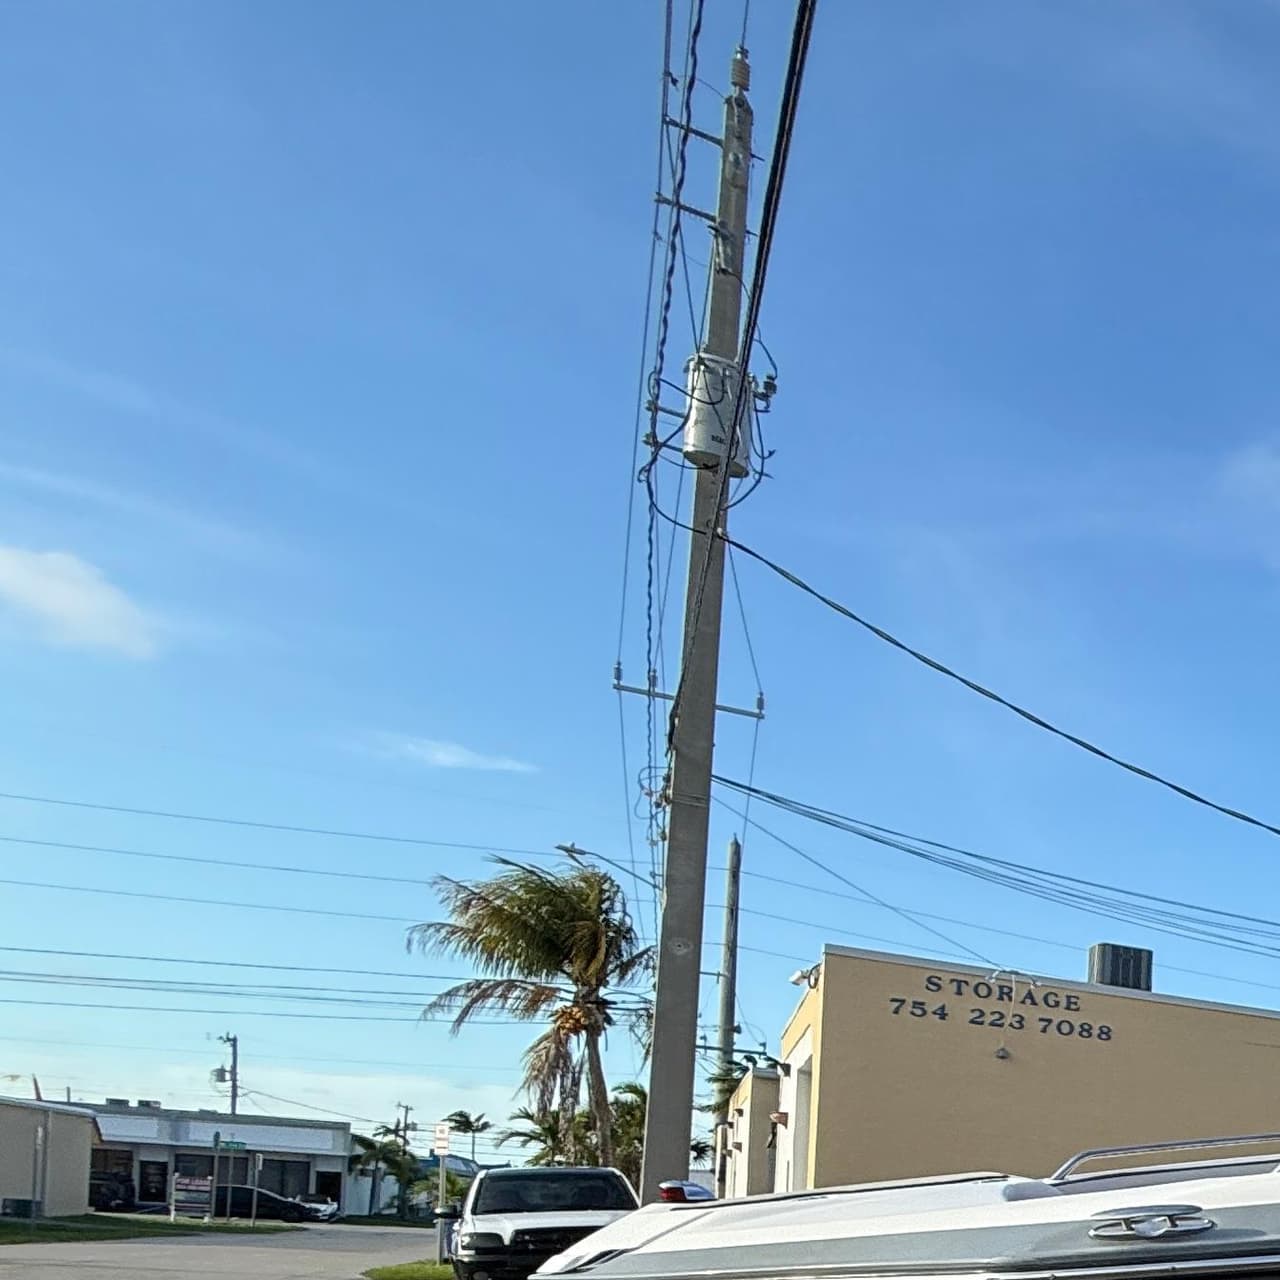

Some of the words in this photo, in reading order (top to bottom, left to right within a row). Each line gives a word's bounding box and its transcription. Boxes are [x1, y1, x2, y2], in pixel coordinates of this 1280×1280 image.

[925, 975, 1081, 1012] STORAGE
[889, 998, 948, 1020] 754
[969, 1008, 1025, 1030] 223
[1038, 1017, 1112, 1041] 7088
